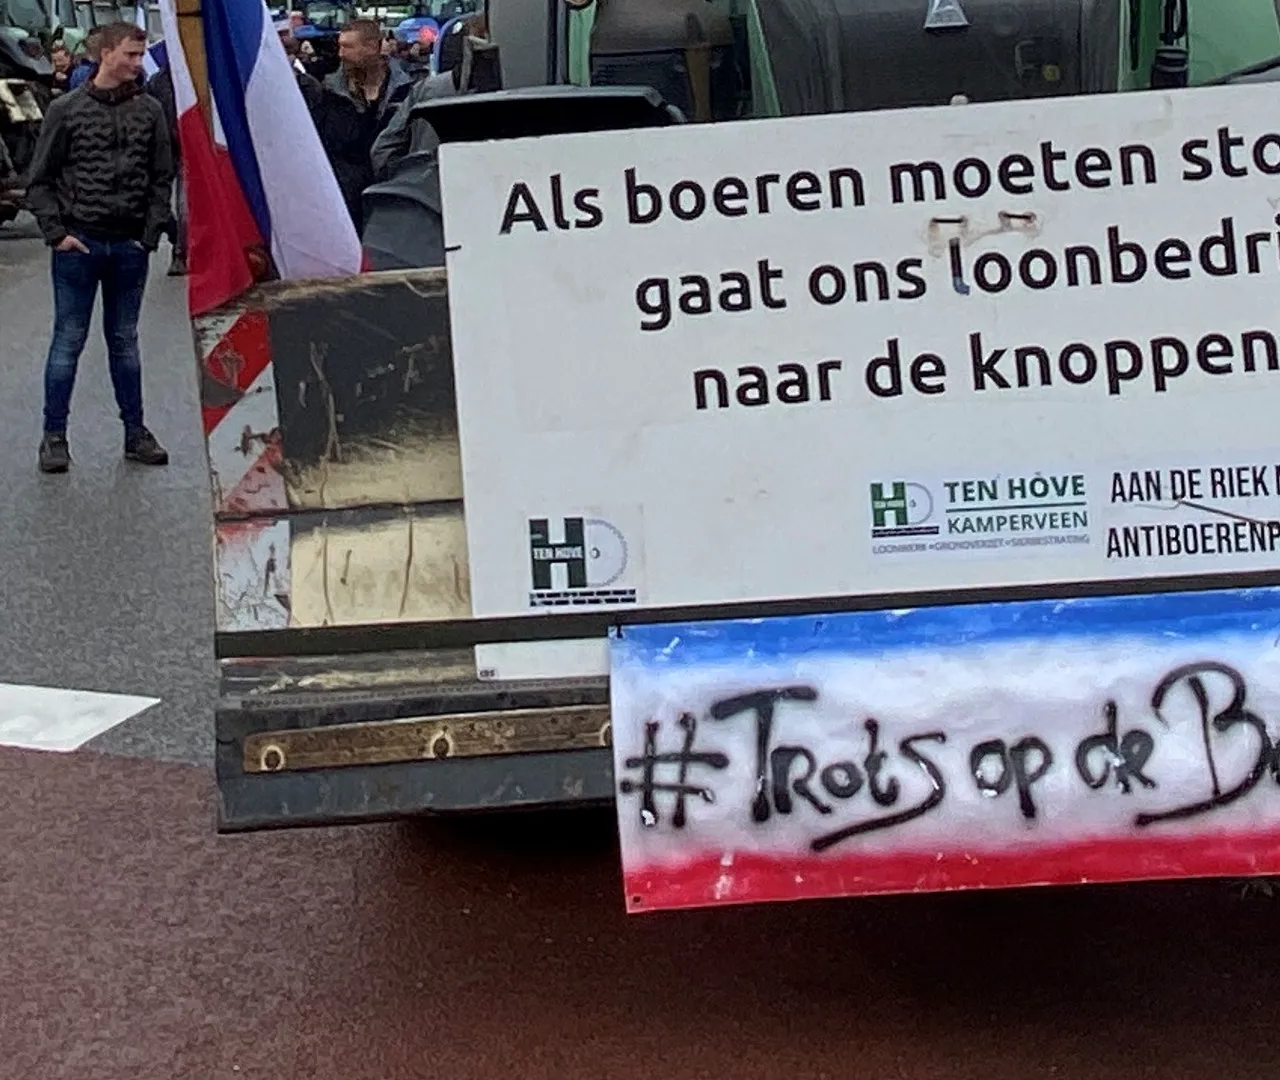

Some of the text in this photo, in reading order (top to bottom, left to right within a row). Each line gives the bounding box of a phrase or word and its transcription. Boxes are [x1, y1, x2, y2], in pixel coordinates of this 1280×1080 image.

[499, 173, 603, 235] Als
[624, 167, 866, 225] boeren
[889, 140, 1157, 204] moeten
[635, 258, 787, 332] gaat
[808, 258, 927, 306] ons
[693, 360, 842, 410] naar
[865, 337, 947, 398] de
[943, 479, 999, 503] TEN
[1111, 470, 1162, 504] AAN
[1169, 468, 1204, 500] DE
[1210, 465, 1270, 499] RIEK
[945, 509, 1088, 534] KAMPERVEEN
[969, 736, 1053, 820] op
[1075, 700, 1156, 793] de
